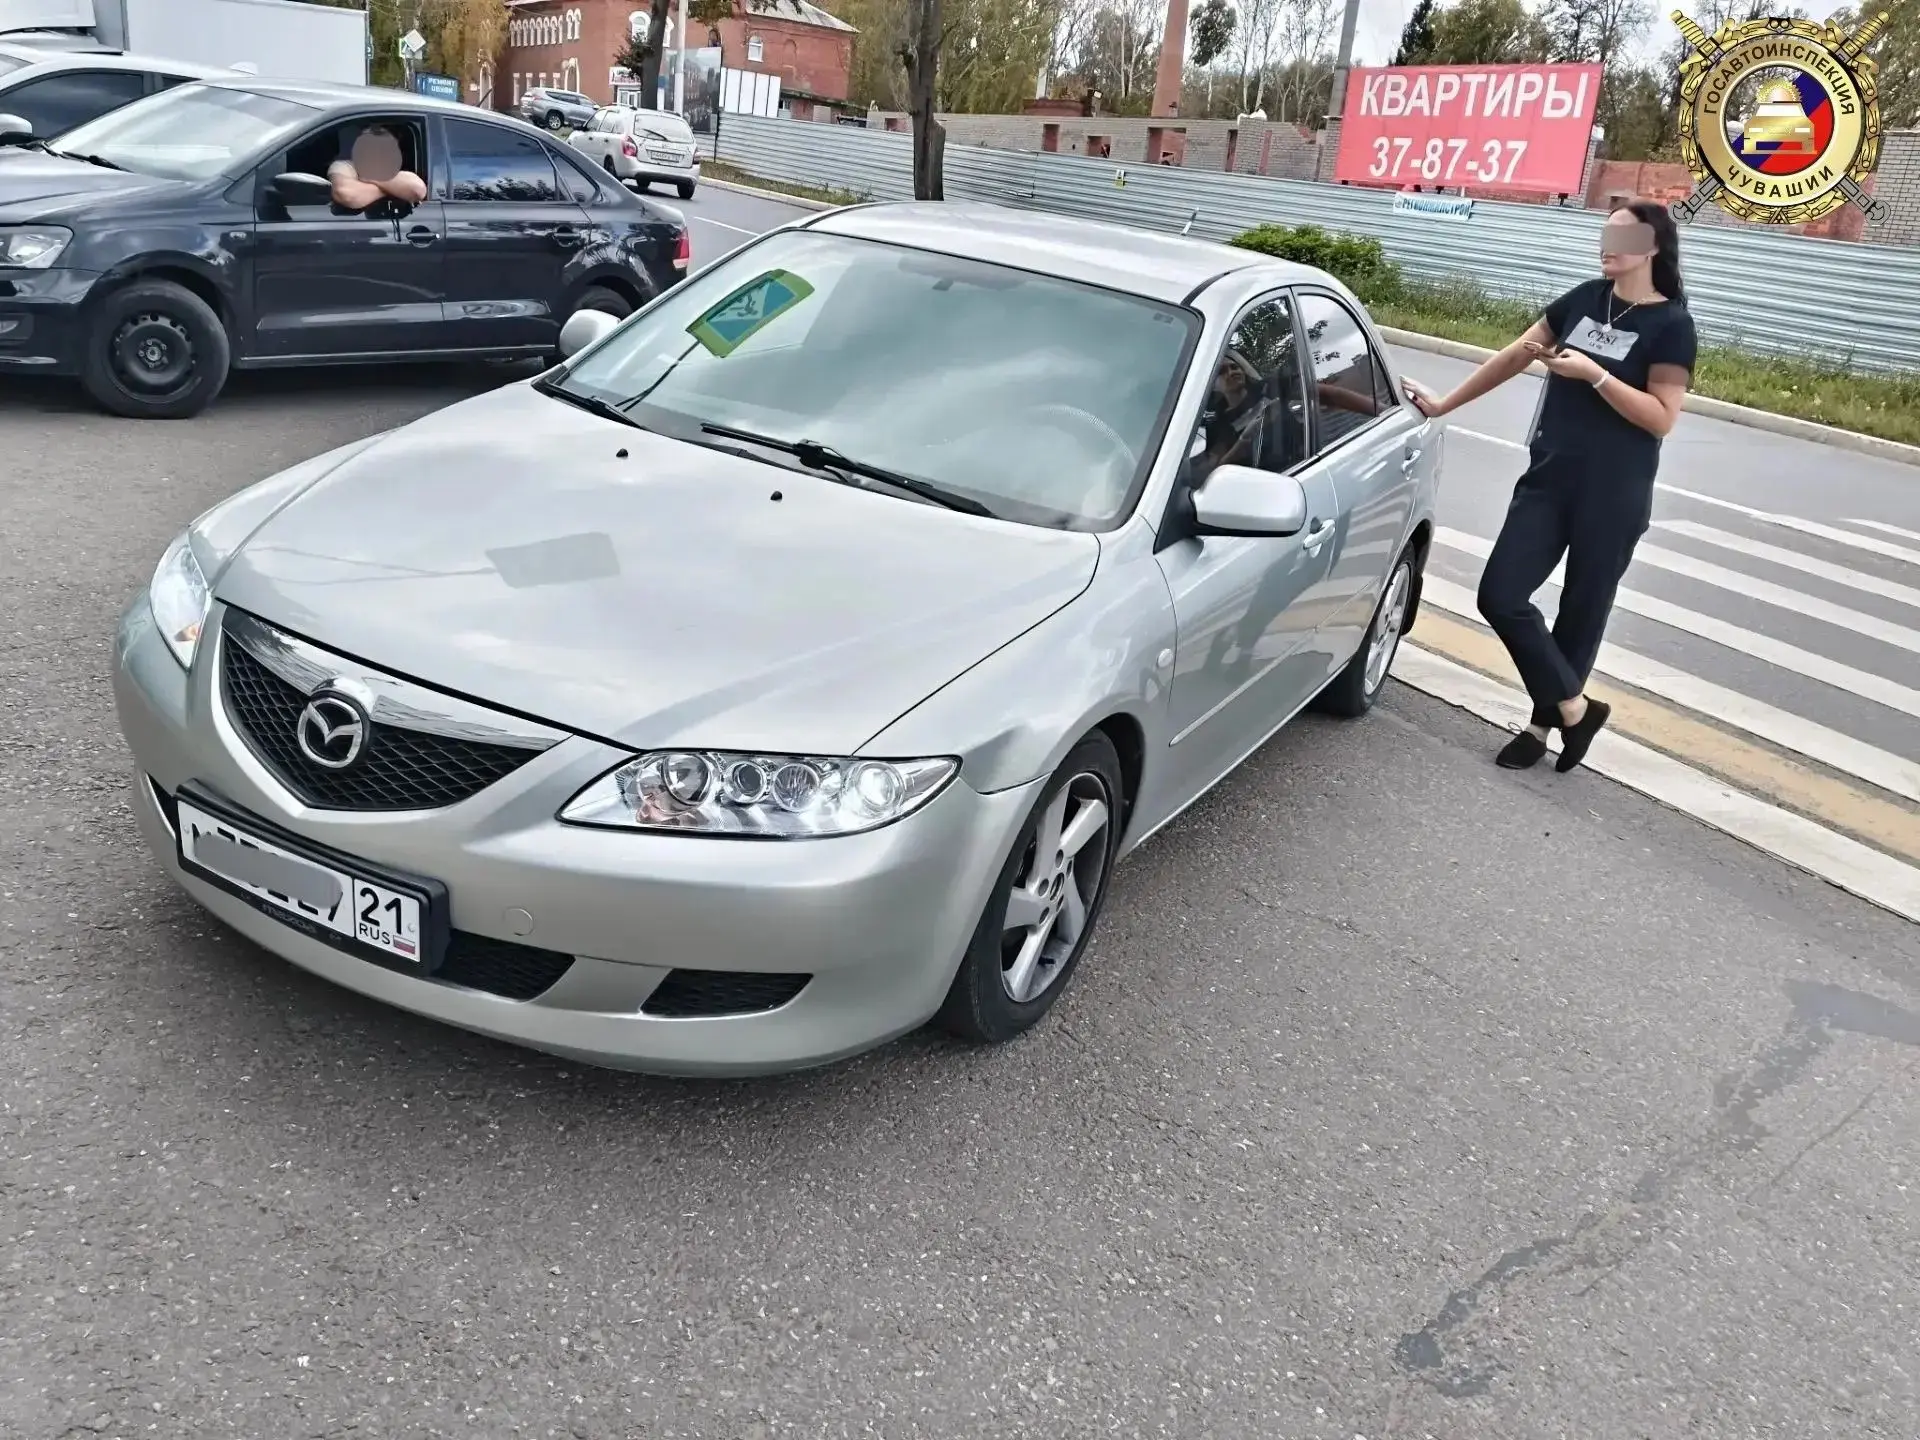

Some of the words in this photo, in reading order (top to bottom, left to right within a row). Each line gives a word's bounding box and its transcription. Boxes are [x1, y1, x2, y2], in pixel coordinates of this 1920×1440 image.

[1359, 72, 1589, 119] КВАРТИРЫ
[1369, 136, 1528, 184] 37-87-37
[359, 922, 391, 945] RUS
[360, 887, 402, 935] 21
